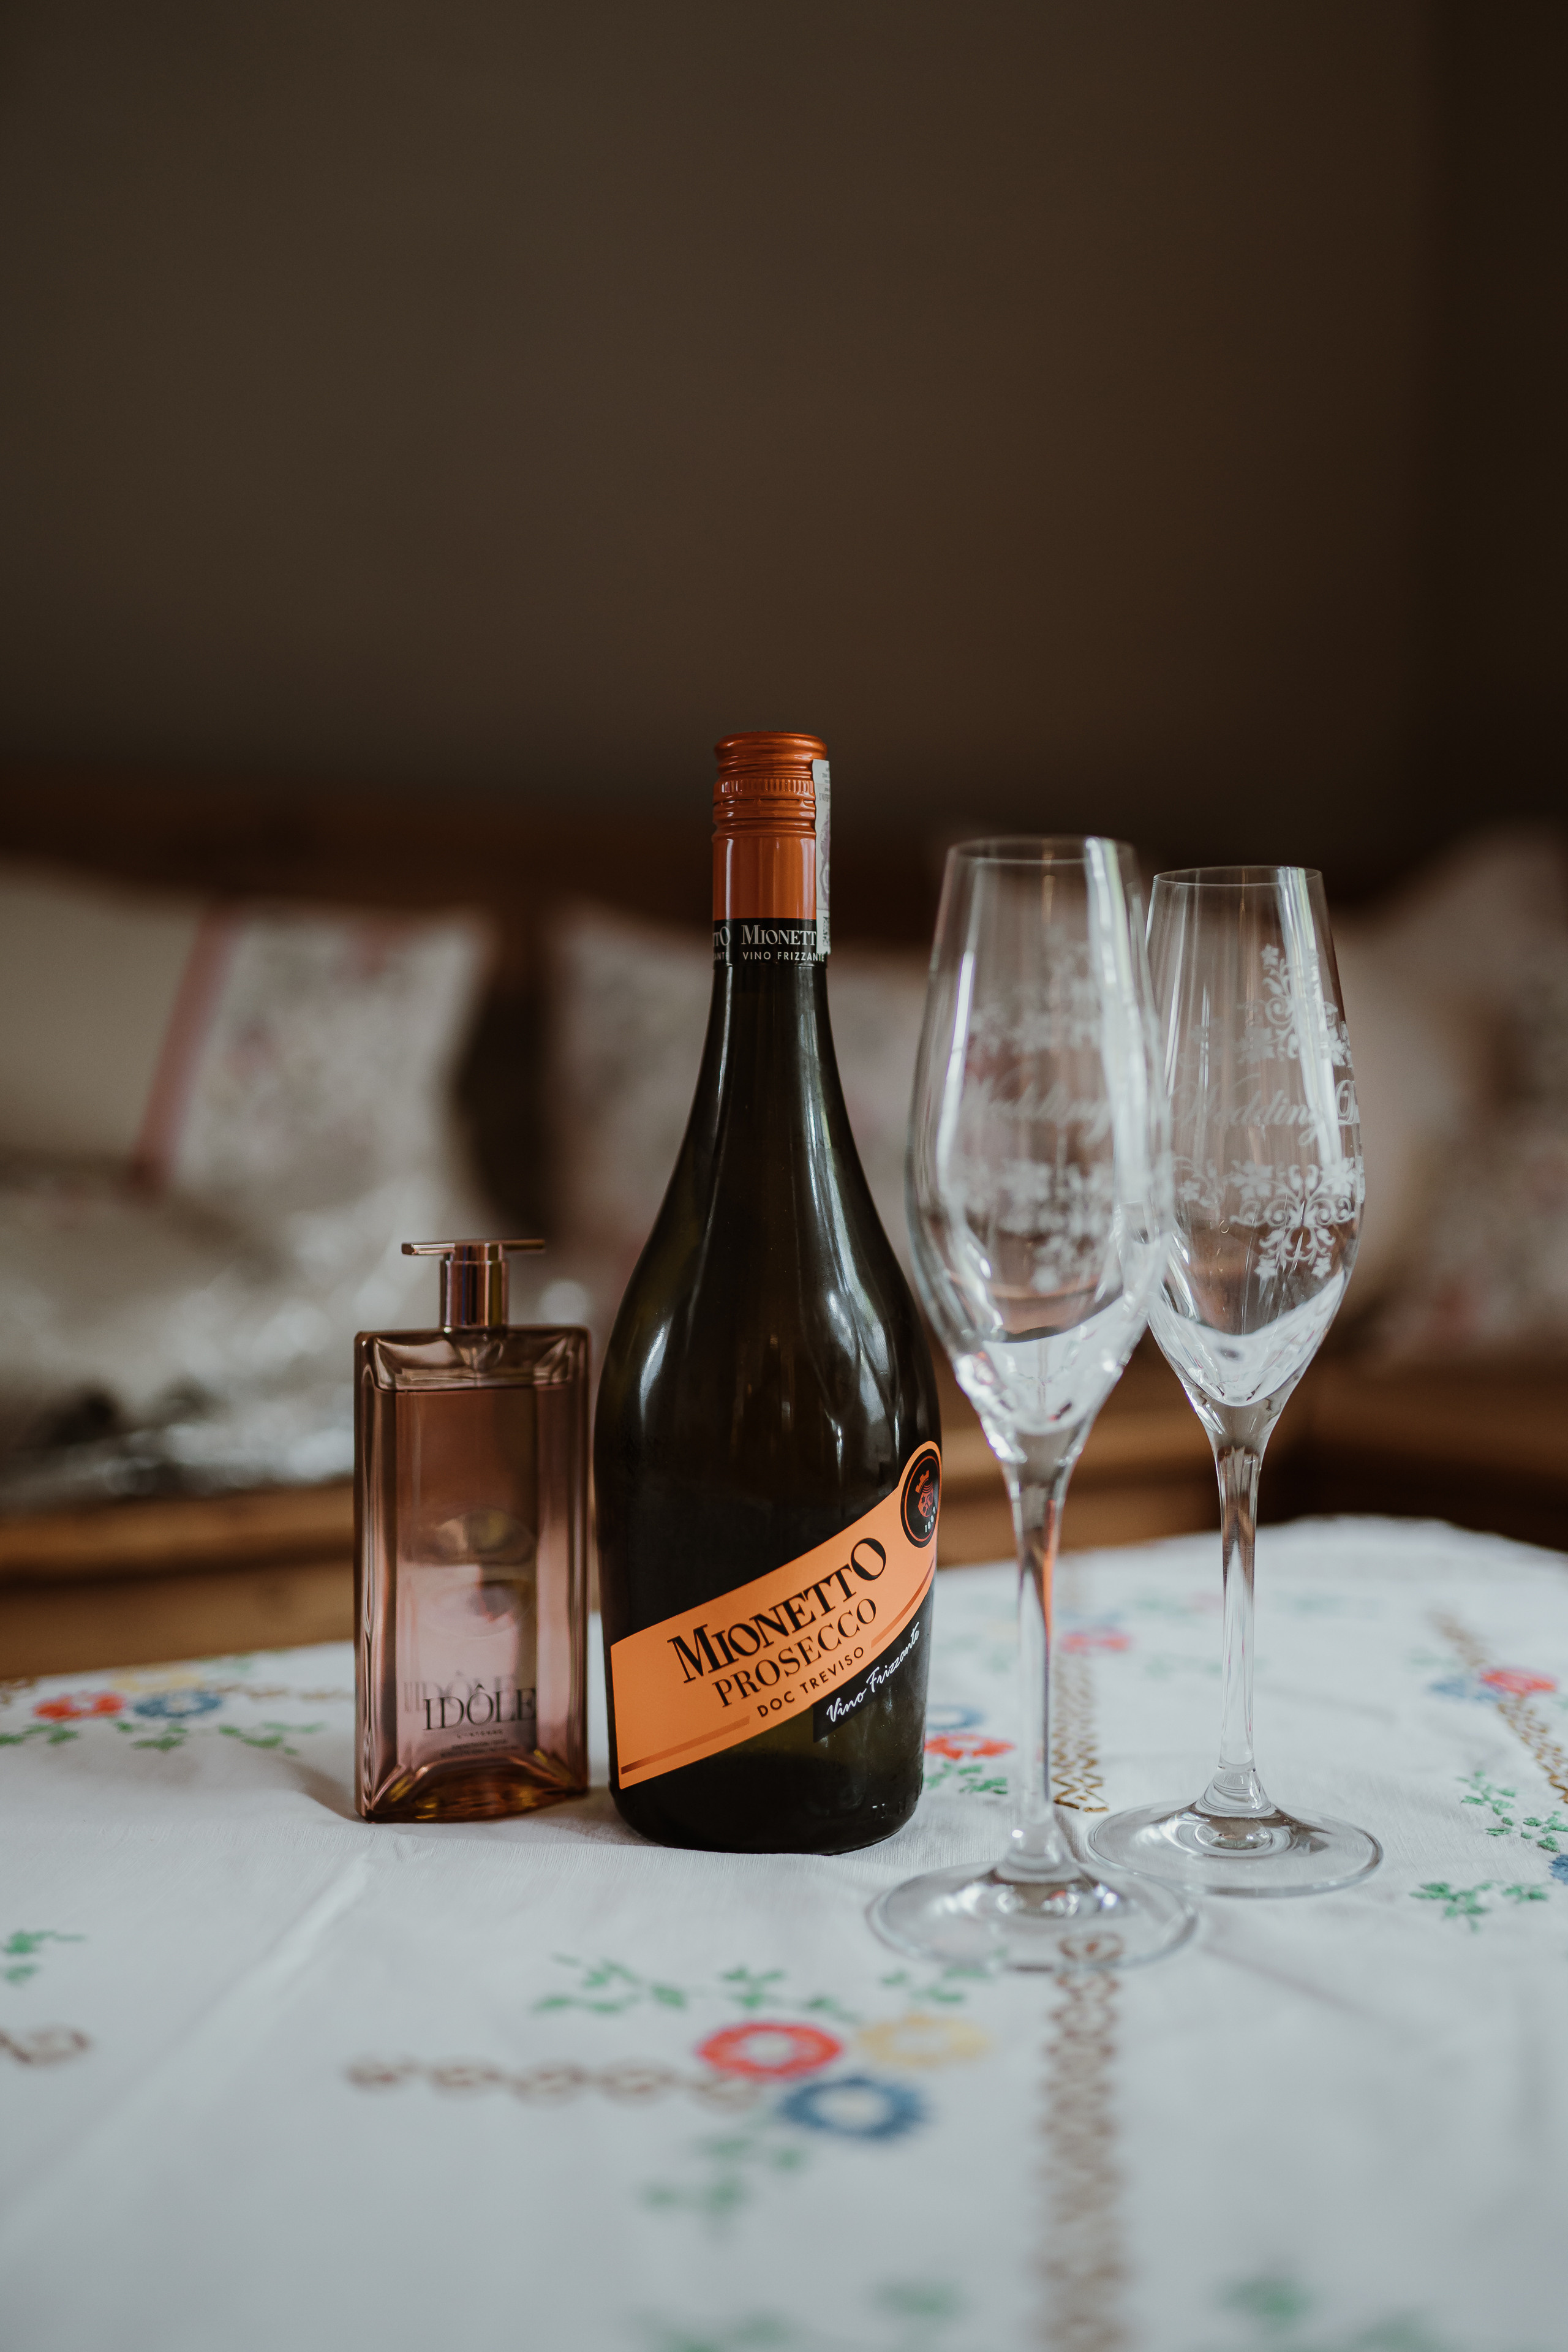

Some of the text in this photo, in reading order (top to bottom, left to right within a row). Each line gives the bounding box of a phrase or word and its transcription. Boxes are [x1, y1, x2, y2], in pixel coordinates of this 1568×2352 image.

[741, 924, 817, 946] MIONETT
[742, 951, 825, 962] VINO FRIZZANTE
[666, 1537, 887, 1684] MIONETTO
[711, 1598, 876, 1708] PROSECCO
[756, 1646, 864, 1718] DOC TREVISO
[826, 1621, 920, 1723] Vino Frizzante
[423, 1683, 537, 1730] IDÔLE
